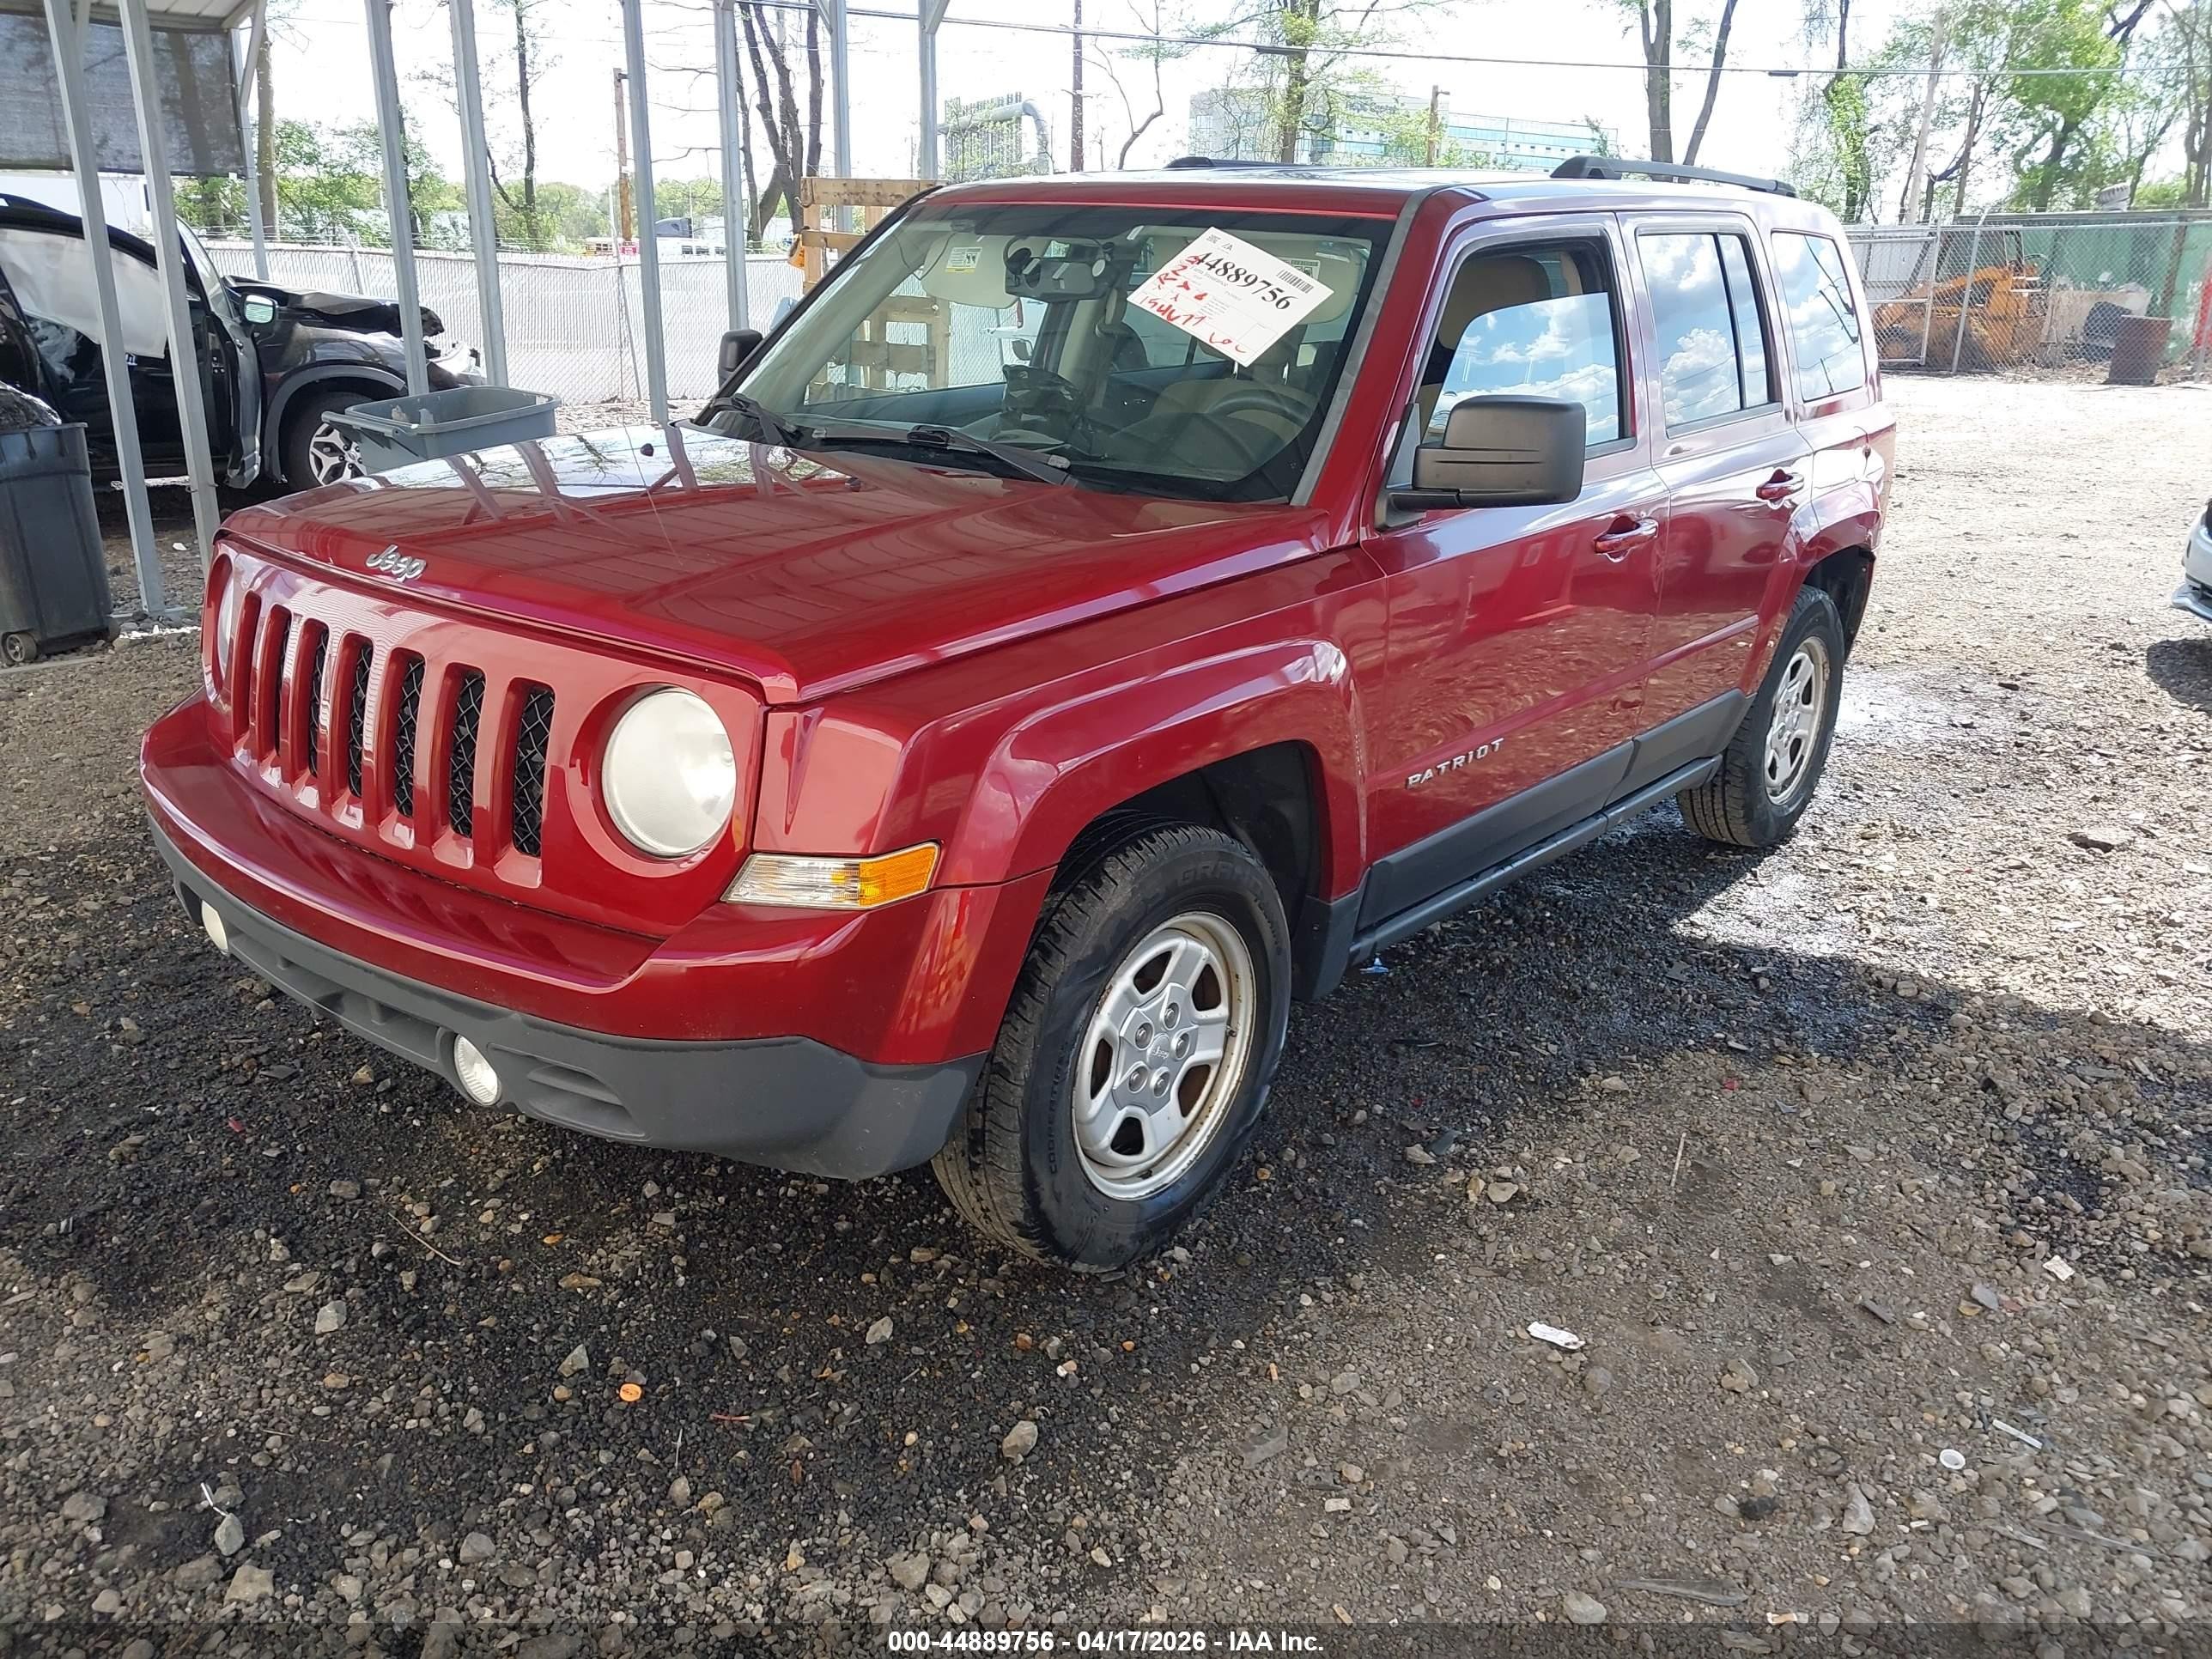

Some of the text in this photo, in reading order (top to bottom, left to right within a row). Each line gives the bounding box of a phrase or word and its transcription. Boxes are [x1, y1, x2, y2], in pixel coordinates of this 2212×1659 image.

[1194, 252, 1298, 310] 44889756
[366, 544, 427, 583] Jeep
[1406, 737, 1504, 789] PATRIOT
